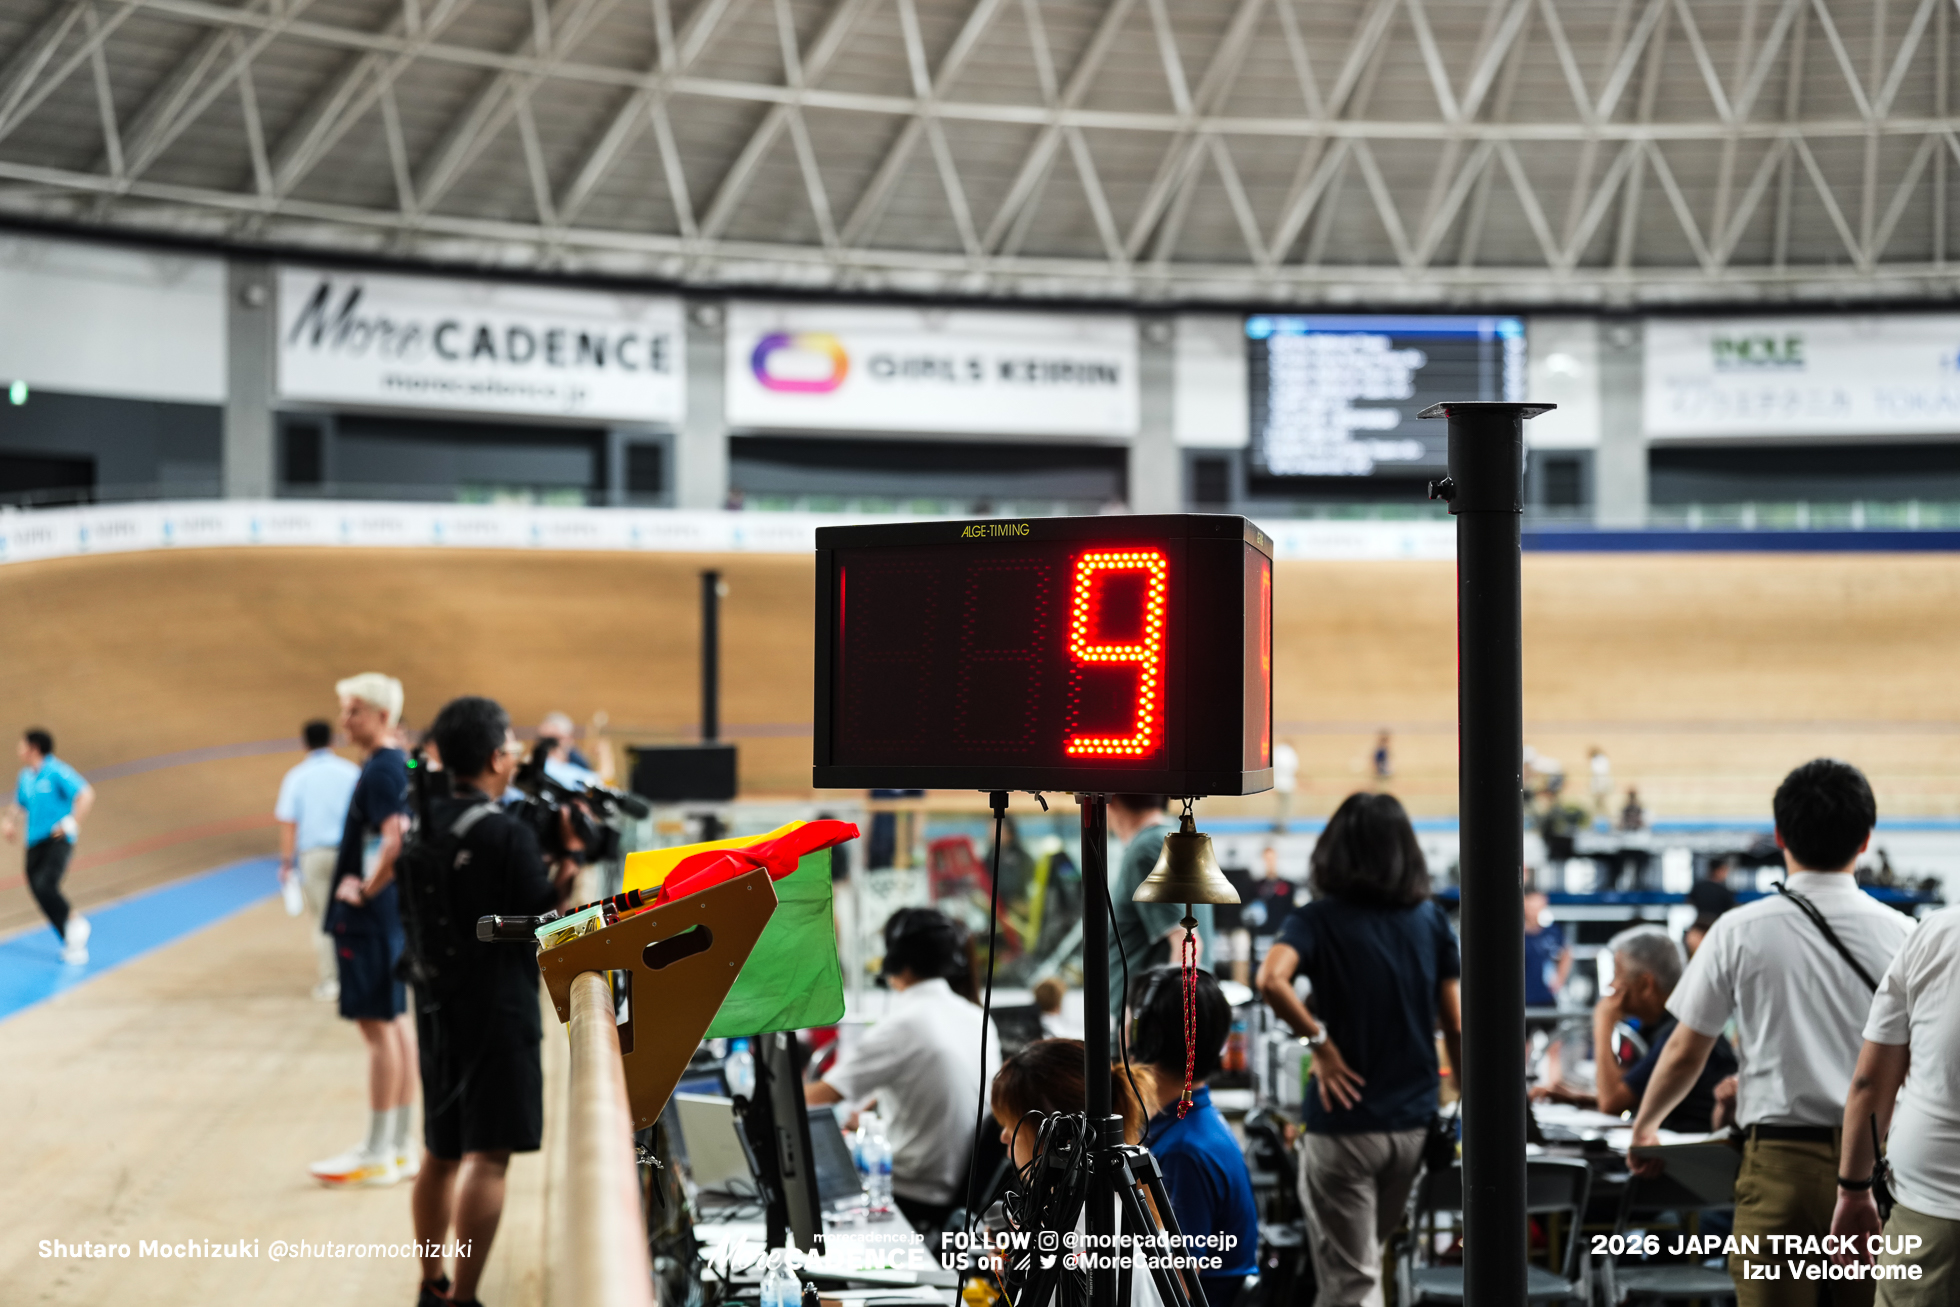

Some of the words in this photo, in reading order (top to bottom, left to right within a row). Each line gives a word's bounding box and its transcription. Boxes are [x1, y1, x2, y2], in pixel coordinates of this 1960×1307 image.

[432, 320, 673, 374] CADENCE
[867, 351, 984, 387] GIRLS
[961, 523, 1030, 538] ALGE-TIMING
[1066, 548, 1168, 759] 9
